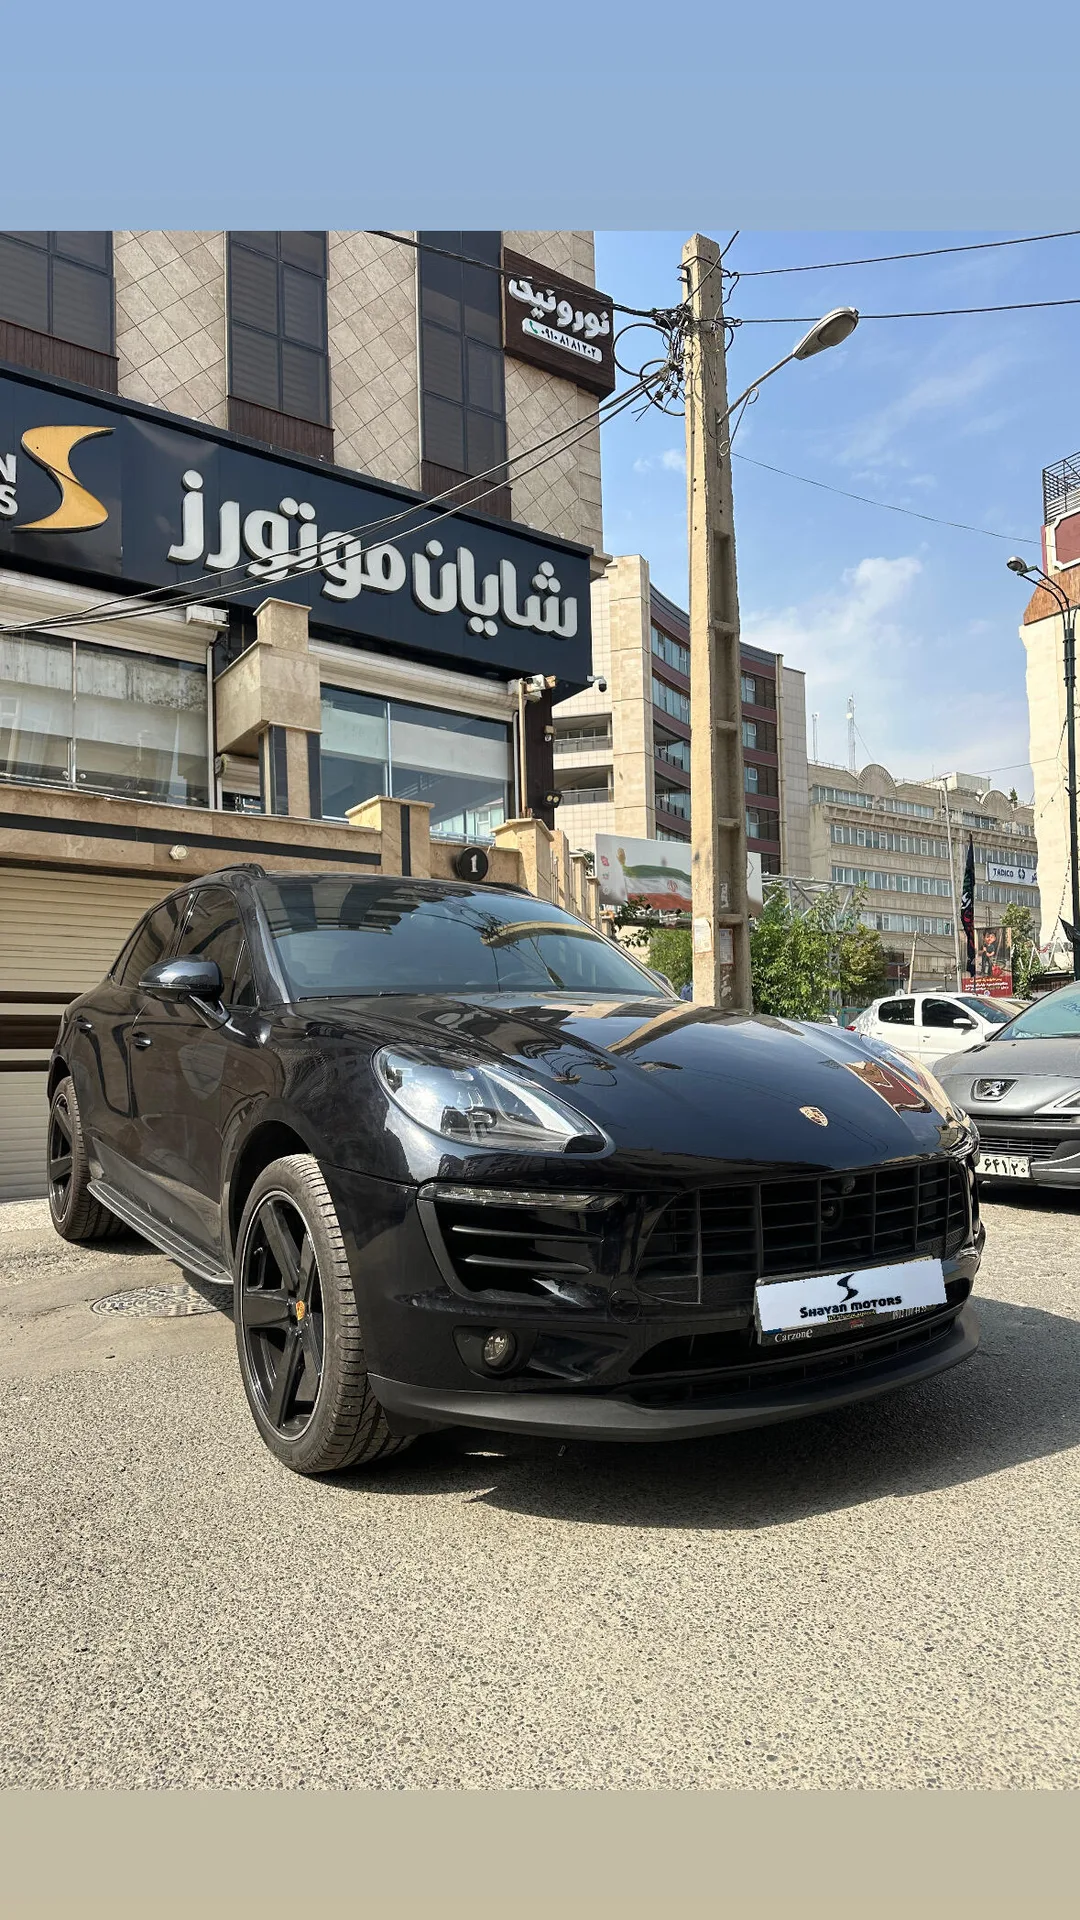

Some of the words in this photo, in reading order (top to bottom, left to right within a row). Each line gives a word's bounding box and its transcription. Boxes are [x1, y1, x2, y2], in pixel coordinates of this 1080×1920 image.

[167, 470, 406, 600] موتورز
[412, 540, 577, 638] شایان
[774, 1328, 813, 1342] Carzone
